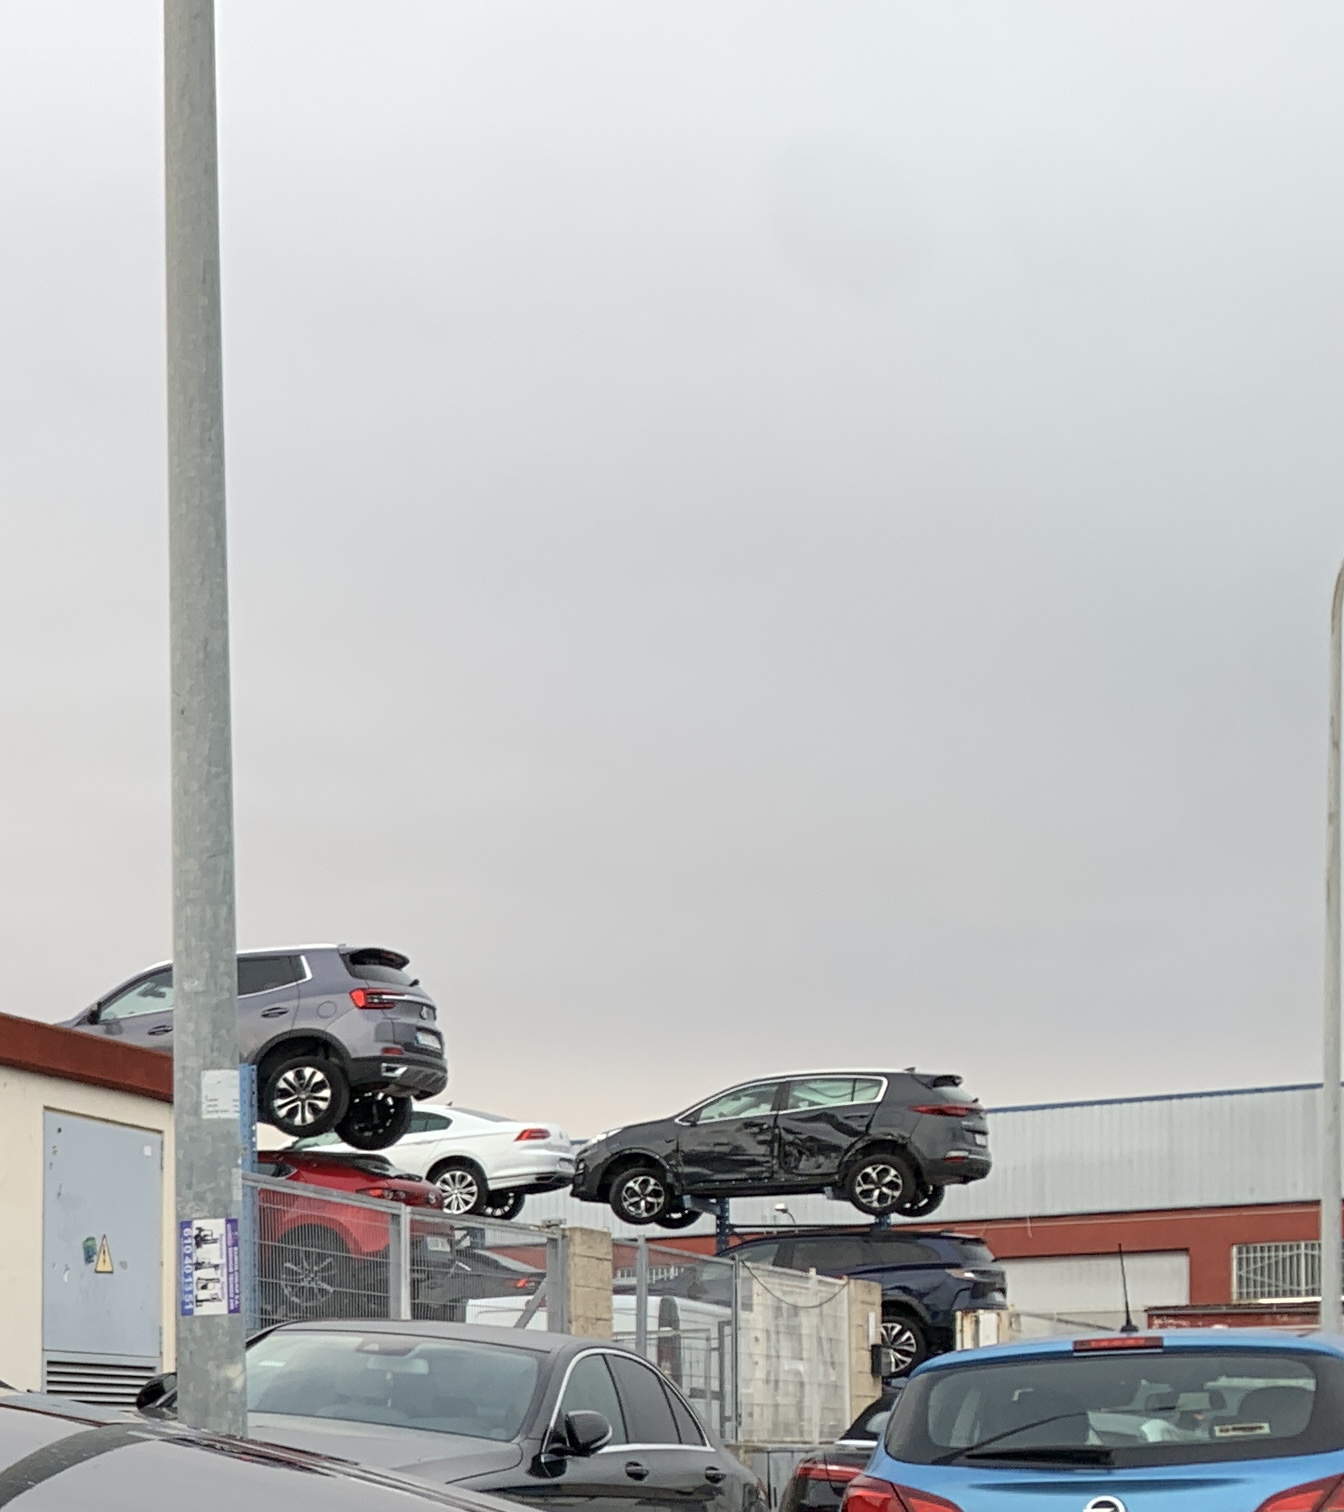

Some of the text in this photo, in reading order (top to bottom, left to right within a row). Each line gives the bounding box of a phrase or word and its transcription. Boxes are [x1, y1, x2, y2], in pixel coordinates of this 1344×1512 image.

[183, 1228, 194, 1310] 610 40 13 51
